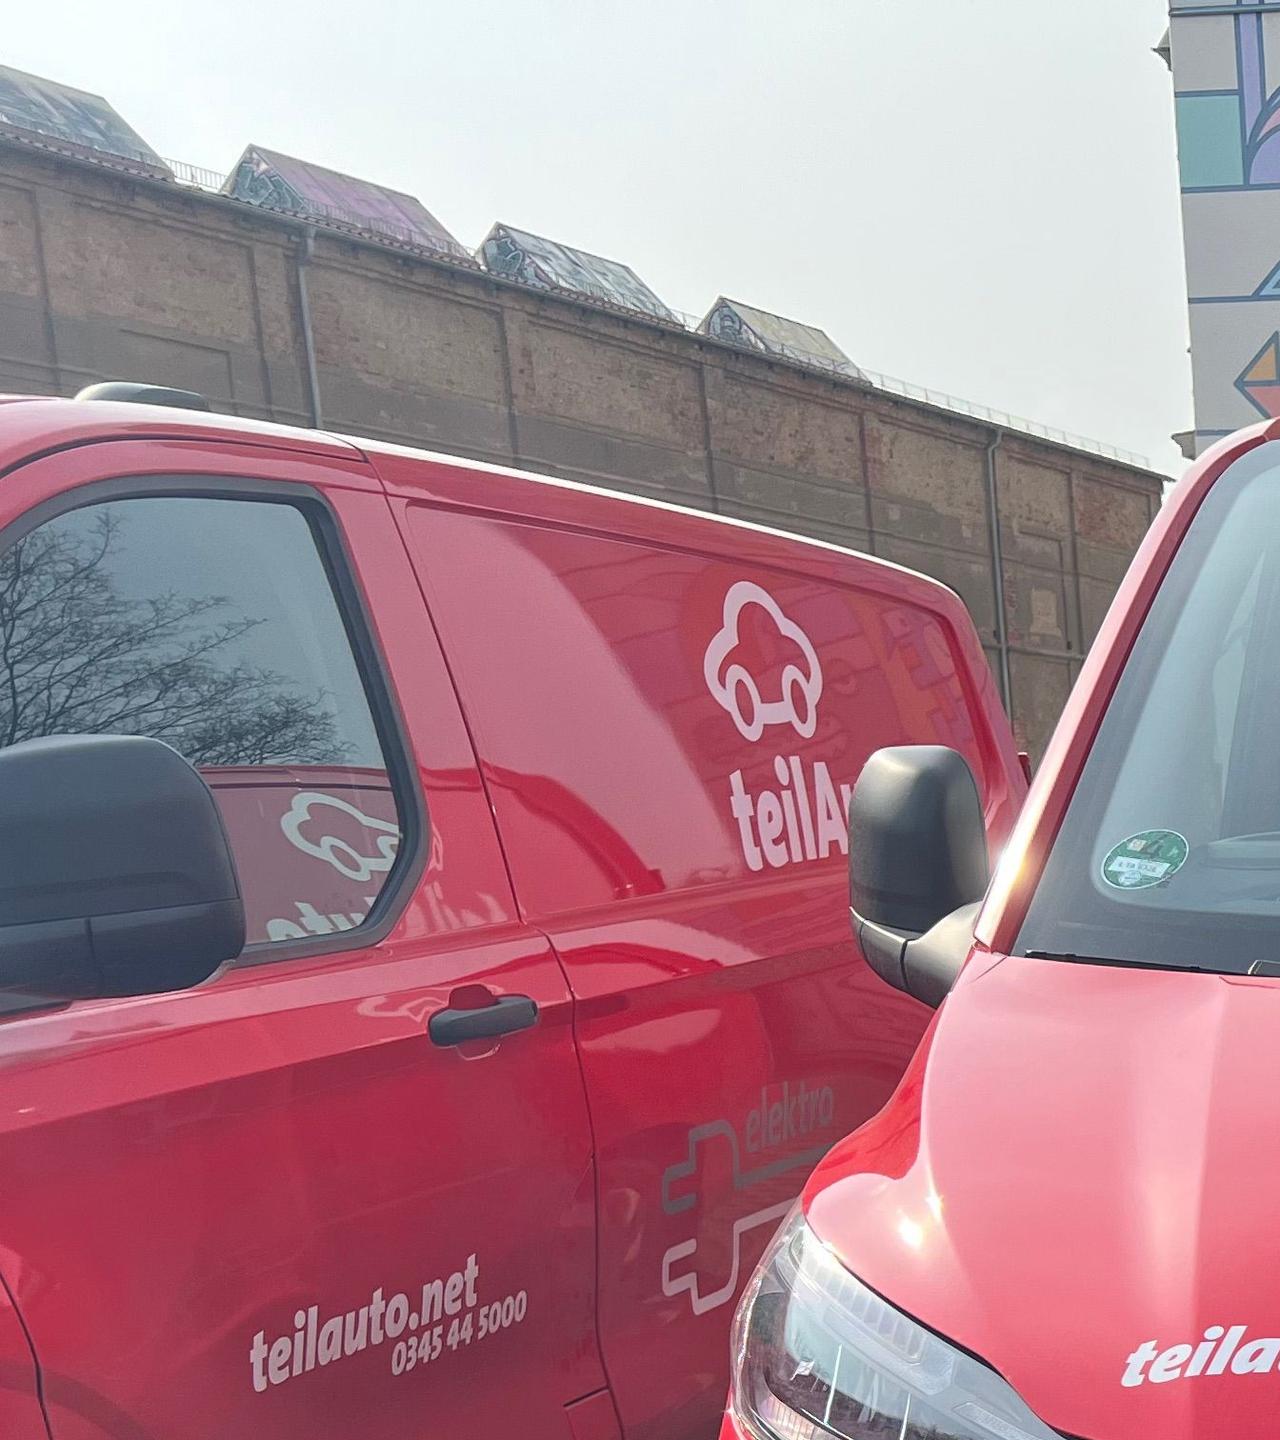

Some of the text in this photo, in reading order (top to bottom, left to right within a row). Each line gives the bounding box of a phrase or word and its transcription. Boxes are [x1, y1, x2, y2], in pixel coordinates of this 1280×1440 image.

[729, 754, 857, 872] teilA
[745, 1081, 834, 1153] elektro
[250, 1253, 479, 1392] teilauto.net
[391, 1290, 528, 1376] 0345 44 5000
